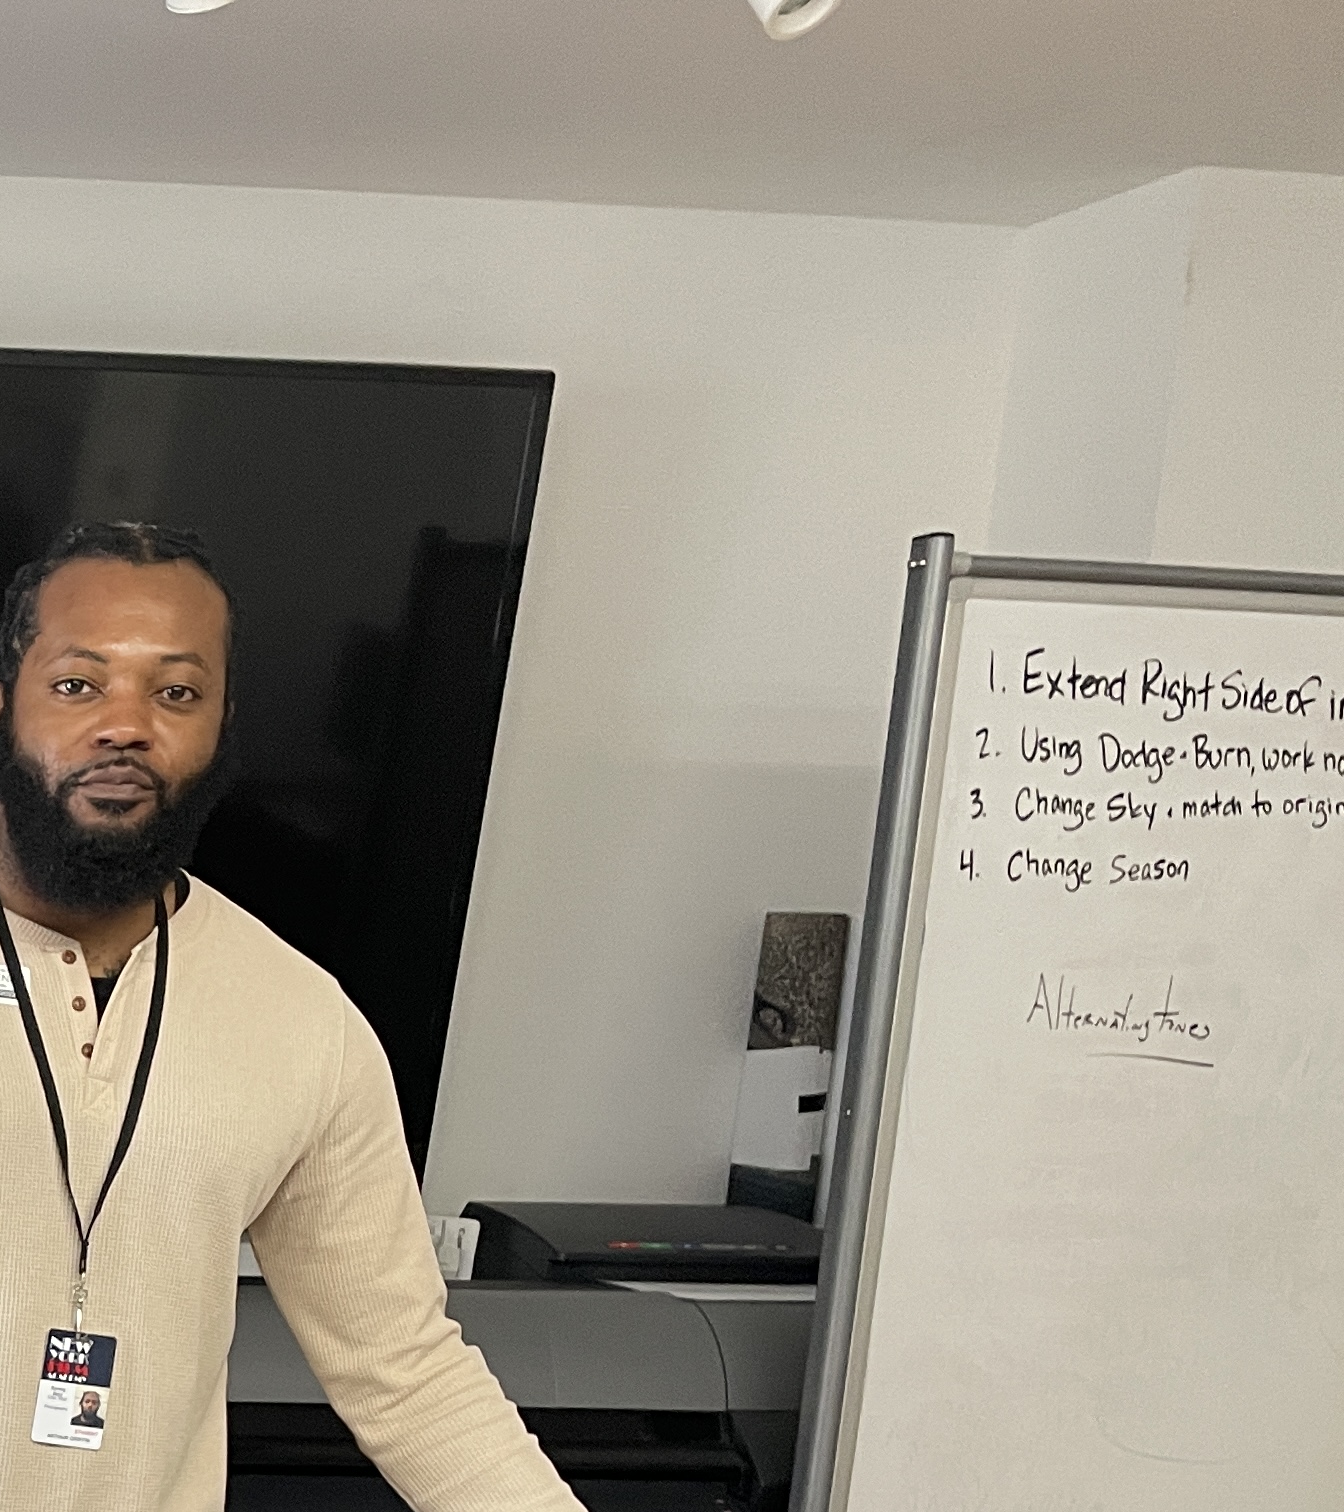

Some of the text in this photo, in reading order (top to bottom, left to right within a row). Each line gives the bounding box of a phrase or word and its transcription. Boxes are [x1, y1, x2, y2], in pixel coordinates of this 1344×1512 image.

[988, 649, 1007, 694] 1.
[1022, 647, 1127, 705] Extend
[1141, 658, 1214, 722] Right
[1220, 669, 1283, 713] Side
[1285, 675, 1322, 717] of
[975, 727, 1001, 759] 2.
[1020, 725, 1082, 776] Using
[1261, 740, 1316, 773] work
[969, 788, 987, 819] 3.
[1014, 786, 1096, 832] Change
[1182, 790, 1243, 820] match
[1250, 788, 1273, 819] to
[959, 848, 1190, 892] 4. Change Season
